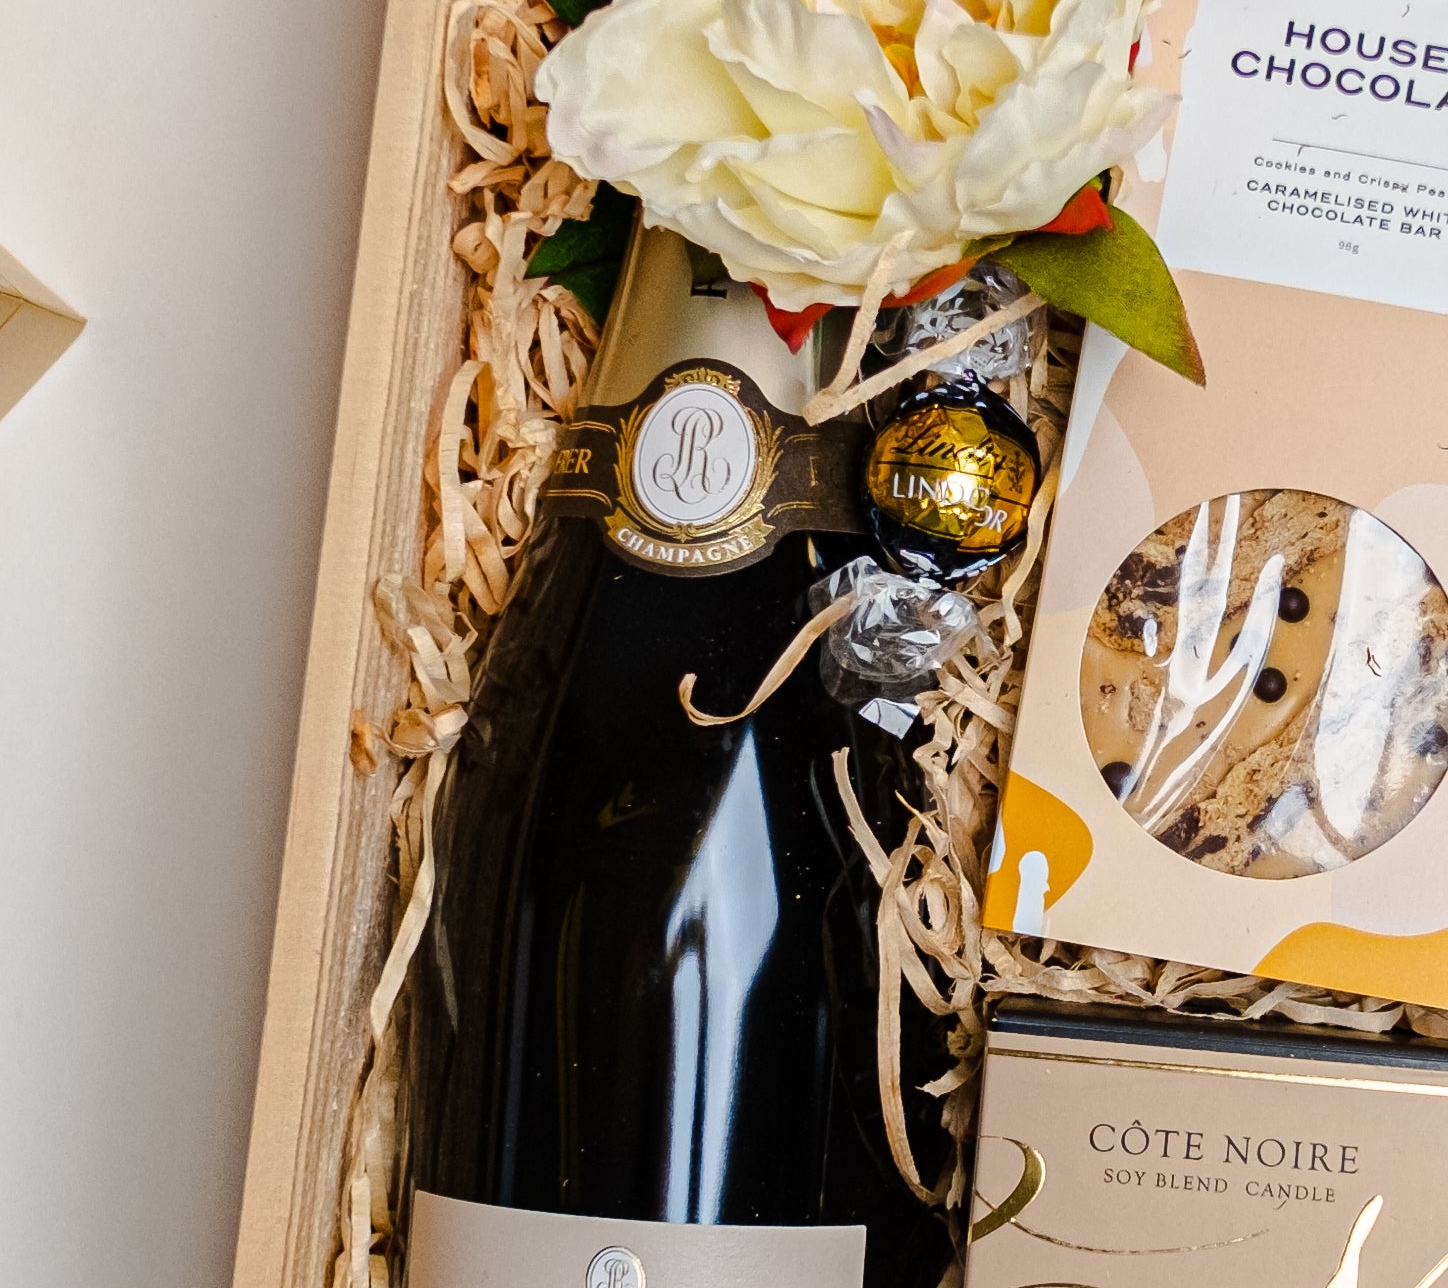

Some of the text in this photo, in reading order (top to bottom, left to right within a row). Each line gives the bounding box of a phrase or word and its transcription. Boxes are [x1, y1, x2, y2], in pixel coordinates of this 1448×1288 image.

[1254, 157, 1316, 176] Cookies
[1323, 169, 1351, 182] and
[1358, 174, 1409, 193] Crispy
[1246, 179, 1395, 214] CARAMELISED
[1267, 199, 1441, 240] CHOCOLATE BAR
[617, 527, 753, 565] CHAMPAGNE
[1088, 1119, 1361, 1175] CÔTE NOIRE
[1103, 1167, 1337, 1205] SOY BLEND CANDLE
